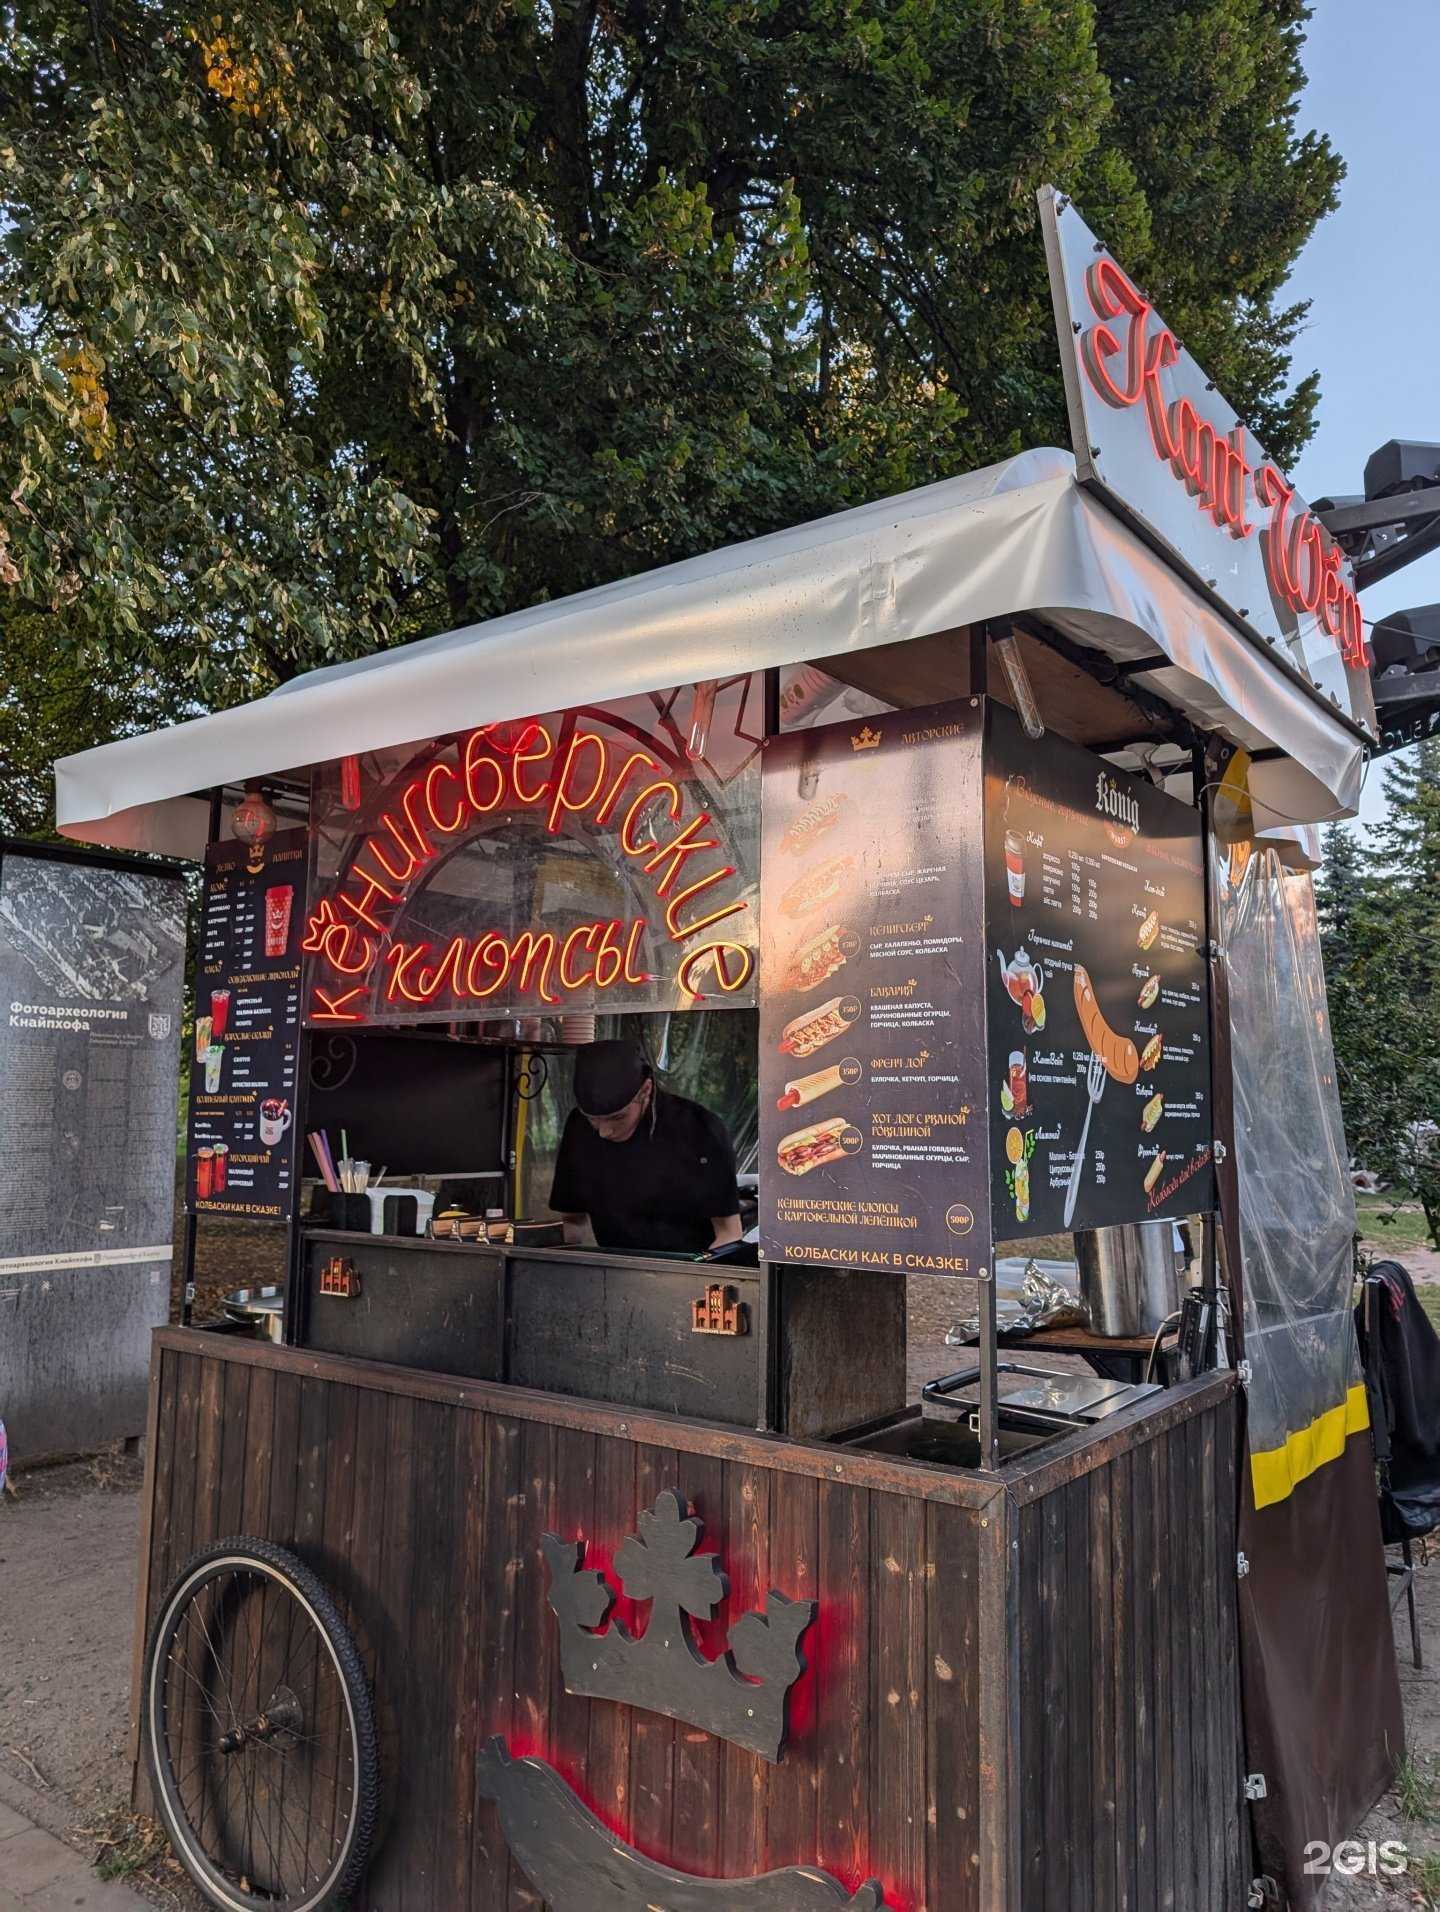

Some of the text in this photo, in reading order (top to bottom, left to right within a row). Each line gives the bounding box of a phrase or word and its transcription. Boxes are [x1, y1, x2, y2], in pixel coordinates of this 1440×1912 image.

[915, 946, 949, 955] КОЛБАСКА
[10, 1001, 128, 1020] Фотоархеология
[904, 1002, 934, 1010] КАПУСТА,
[870, 1012, 922, 1020] МАРИНОВАННЫЕ
[9, 1015, 90, 1032] Кнайпхофа
[901, 1019, 935, 1028] КОЛБАСКА
[871, 1076, 901, 1084] БУЛОЧКА,
[872, 1113, 892, 1124] ХОТ
[924, 1112, 966, 1126] РВАНОЙ
[871, 1126, 931, 1138] ГОВЯДИНОЙ
[871, 1144, 965, 1154] БУЛОЧКА, РВАНАЯ ГОВЯДИНА,
[871, 1153, 925, 1161] МАРИНОВАННЫЕ
[858, 1201, 899, 1214] КЛОПСЫ
[784, 1211, 858, 1226] КАРТОФЕЛЬНОЙ
[785, 1245, 970, 1272] КОЛБАСКИ КАК В СКАЗКЕ!
